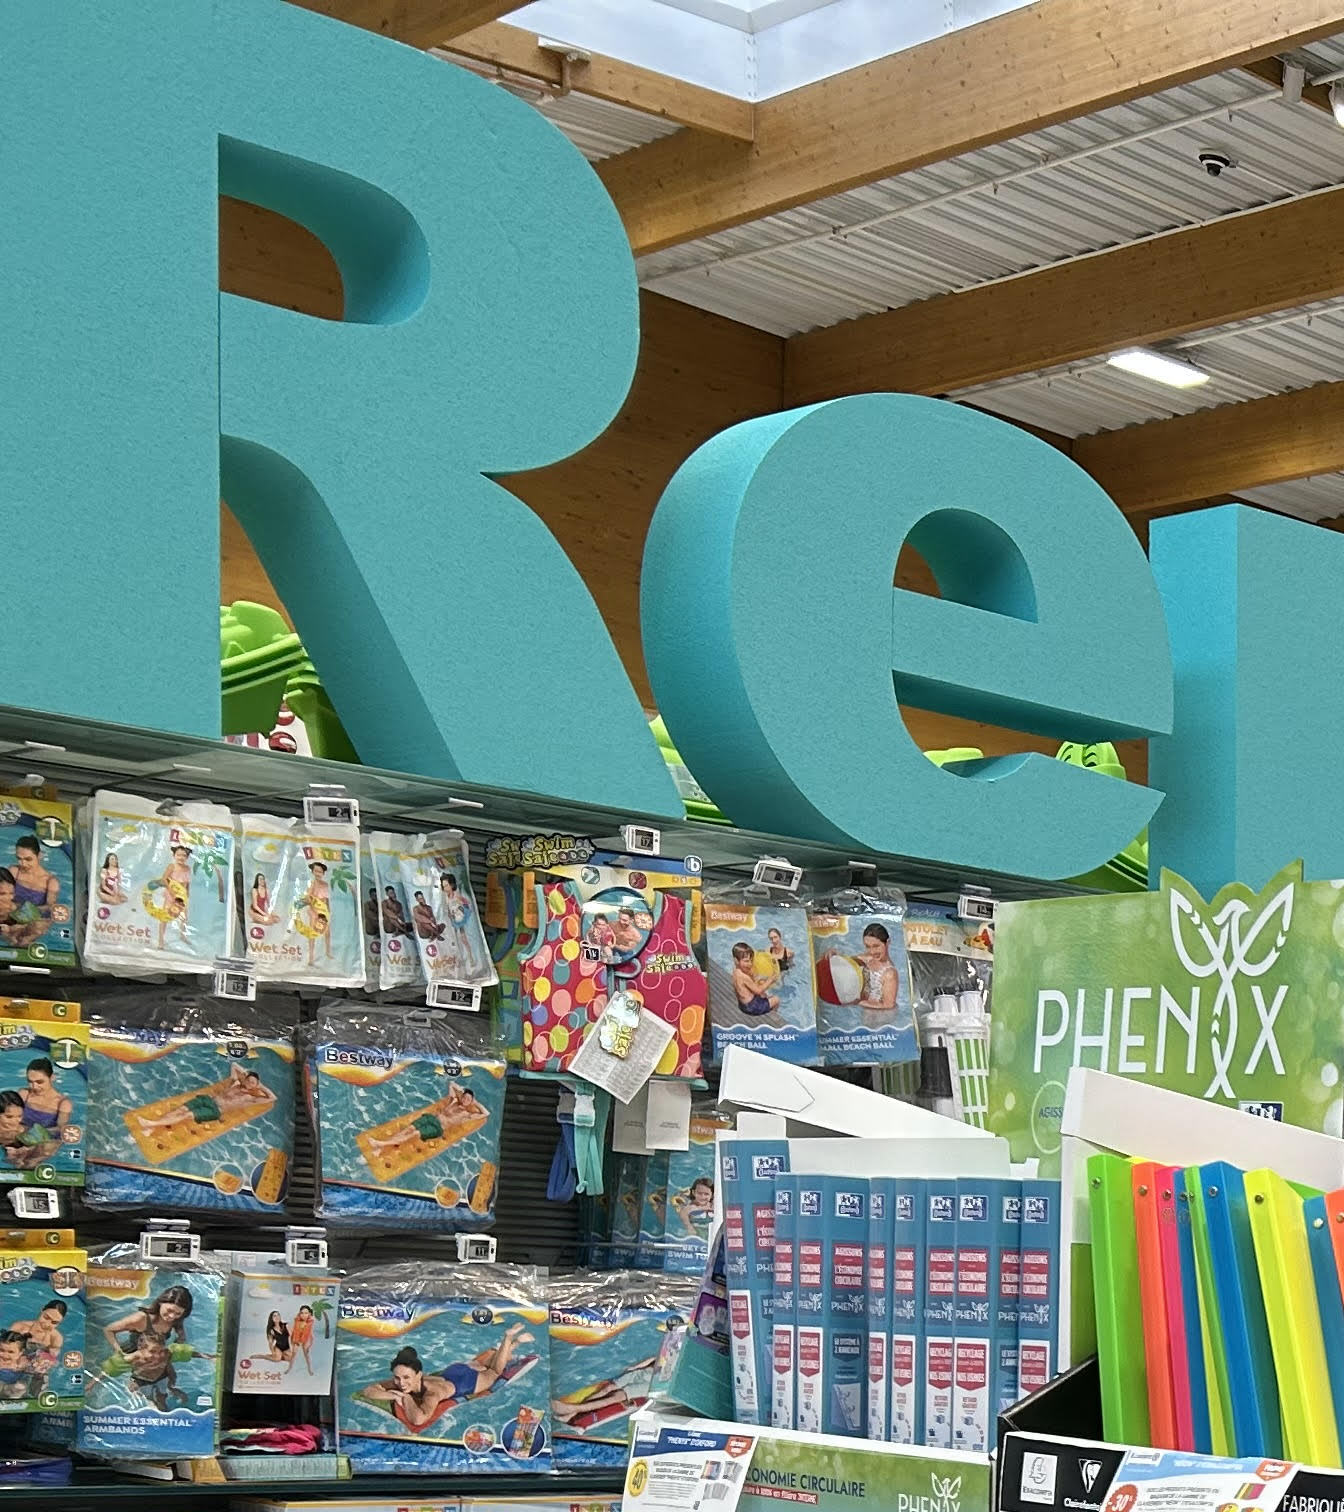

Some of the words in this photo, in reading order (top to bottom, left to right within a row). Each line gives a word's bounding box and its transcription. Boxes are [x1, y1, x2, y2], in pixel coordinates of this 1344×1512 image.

[324, 1048, 396, 1070] Bestway
[341, 1303, 417, 1322] Bestway
[83, 1415, 131, 1426] SUMMER
[83, 1424, 146, 1436] ARMBANDS
[799, 1474, 866, 1498] CIRCULAIRE
